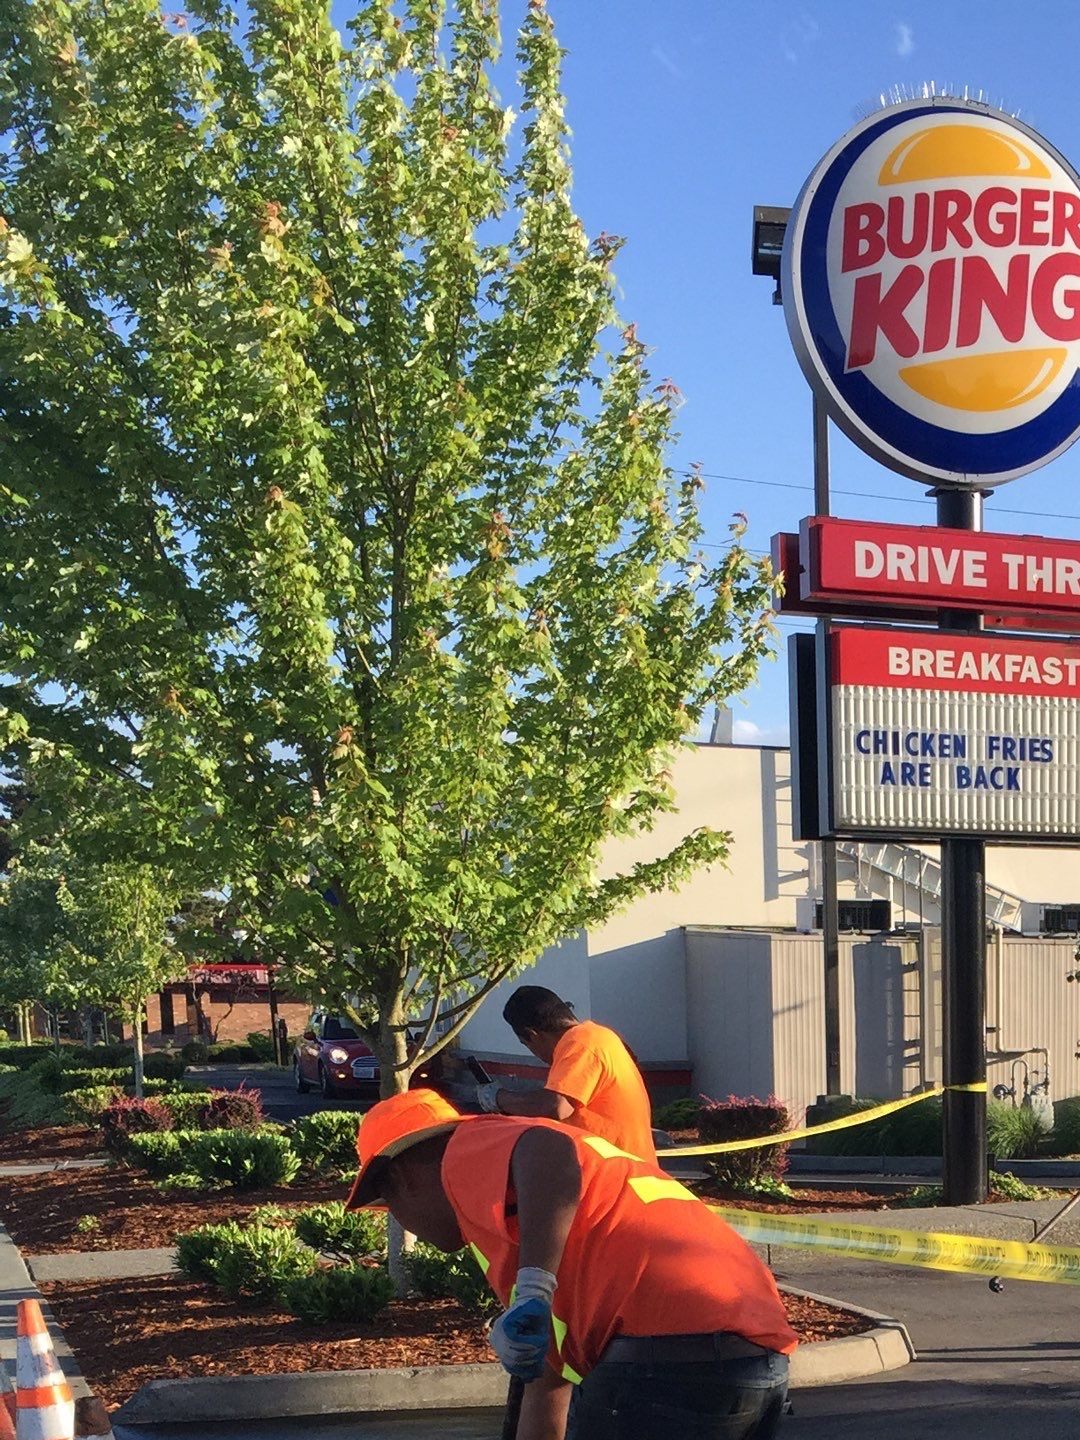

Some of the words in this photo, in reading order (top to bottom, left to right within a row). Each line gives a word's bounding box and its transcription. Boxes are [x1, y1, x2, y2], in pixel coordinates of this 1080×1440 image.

[853, 540, 988, 588] DRIVE
[855, 728, 967, 760] CHICKEN
[987, 735, 1054, 764] FRIES
[880, 760, 932, 788] ARE
[956, 765, 1021, 792] BACK
